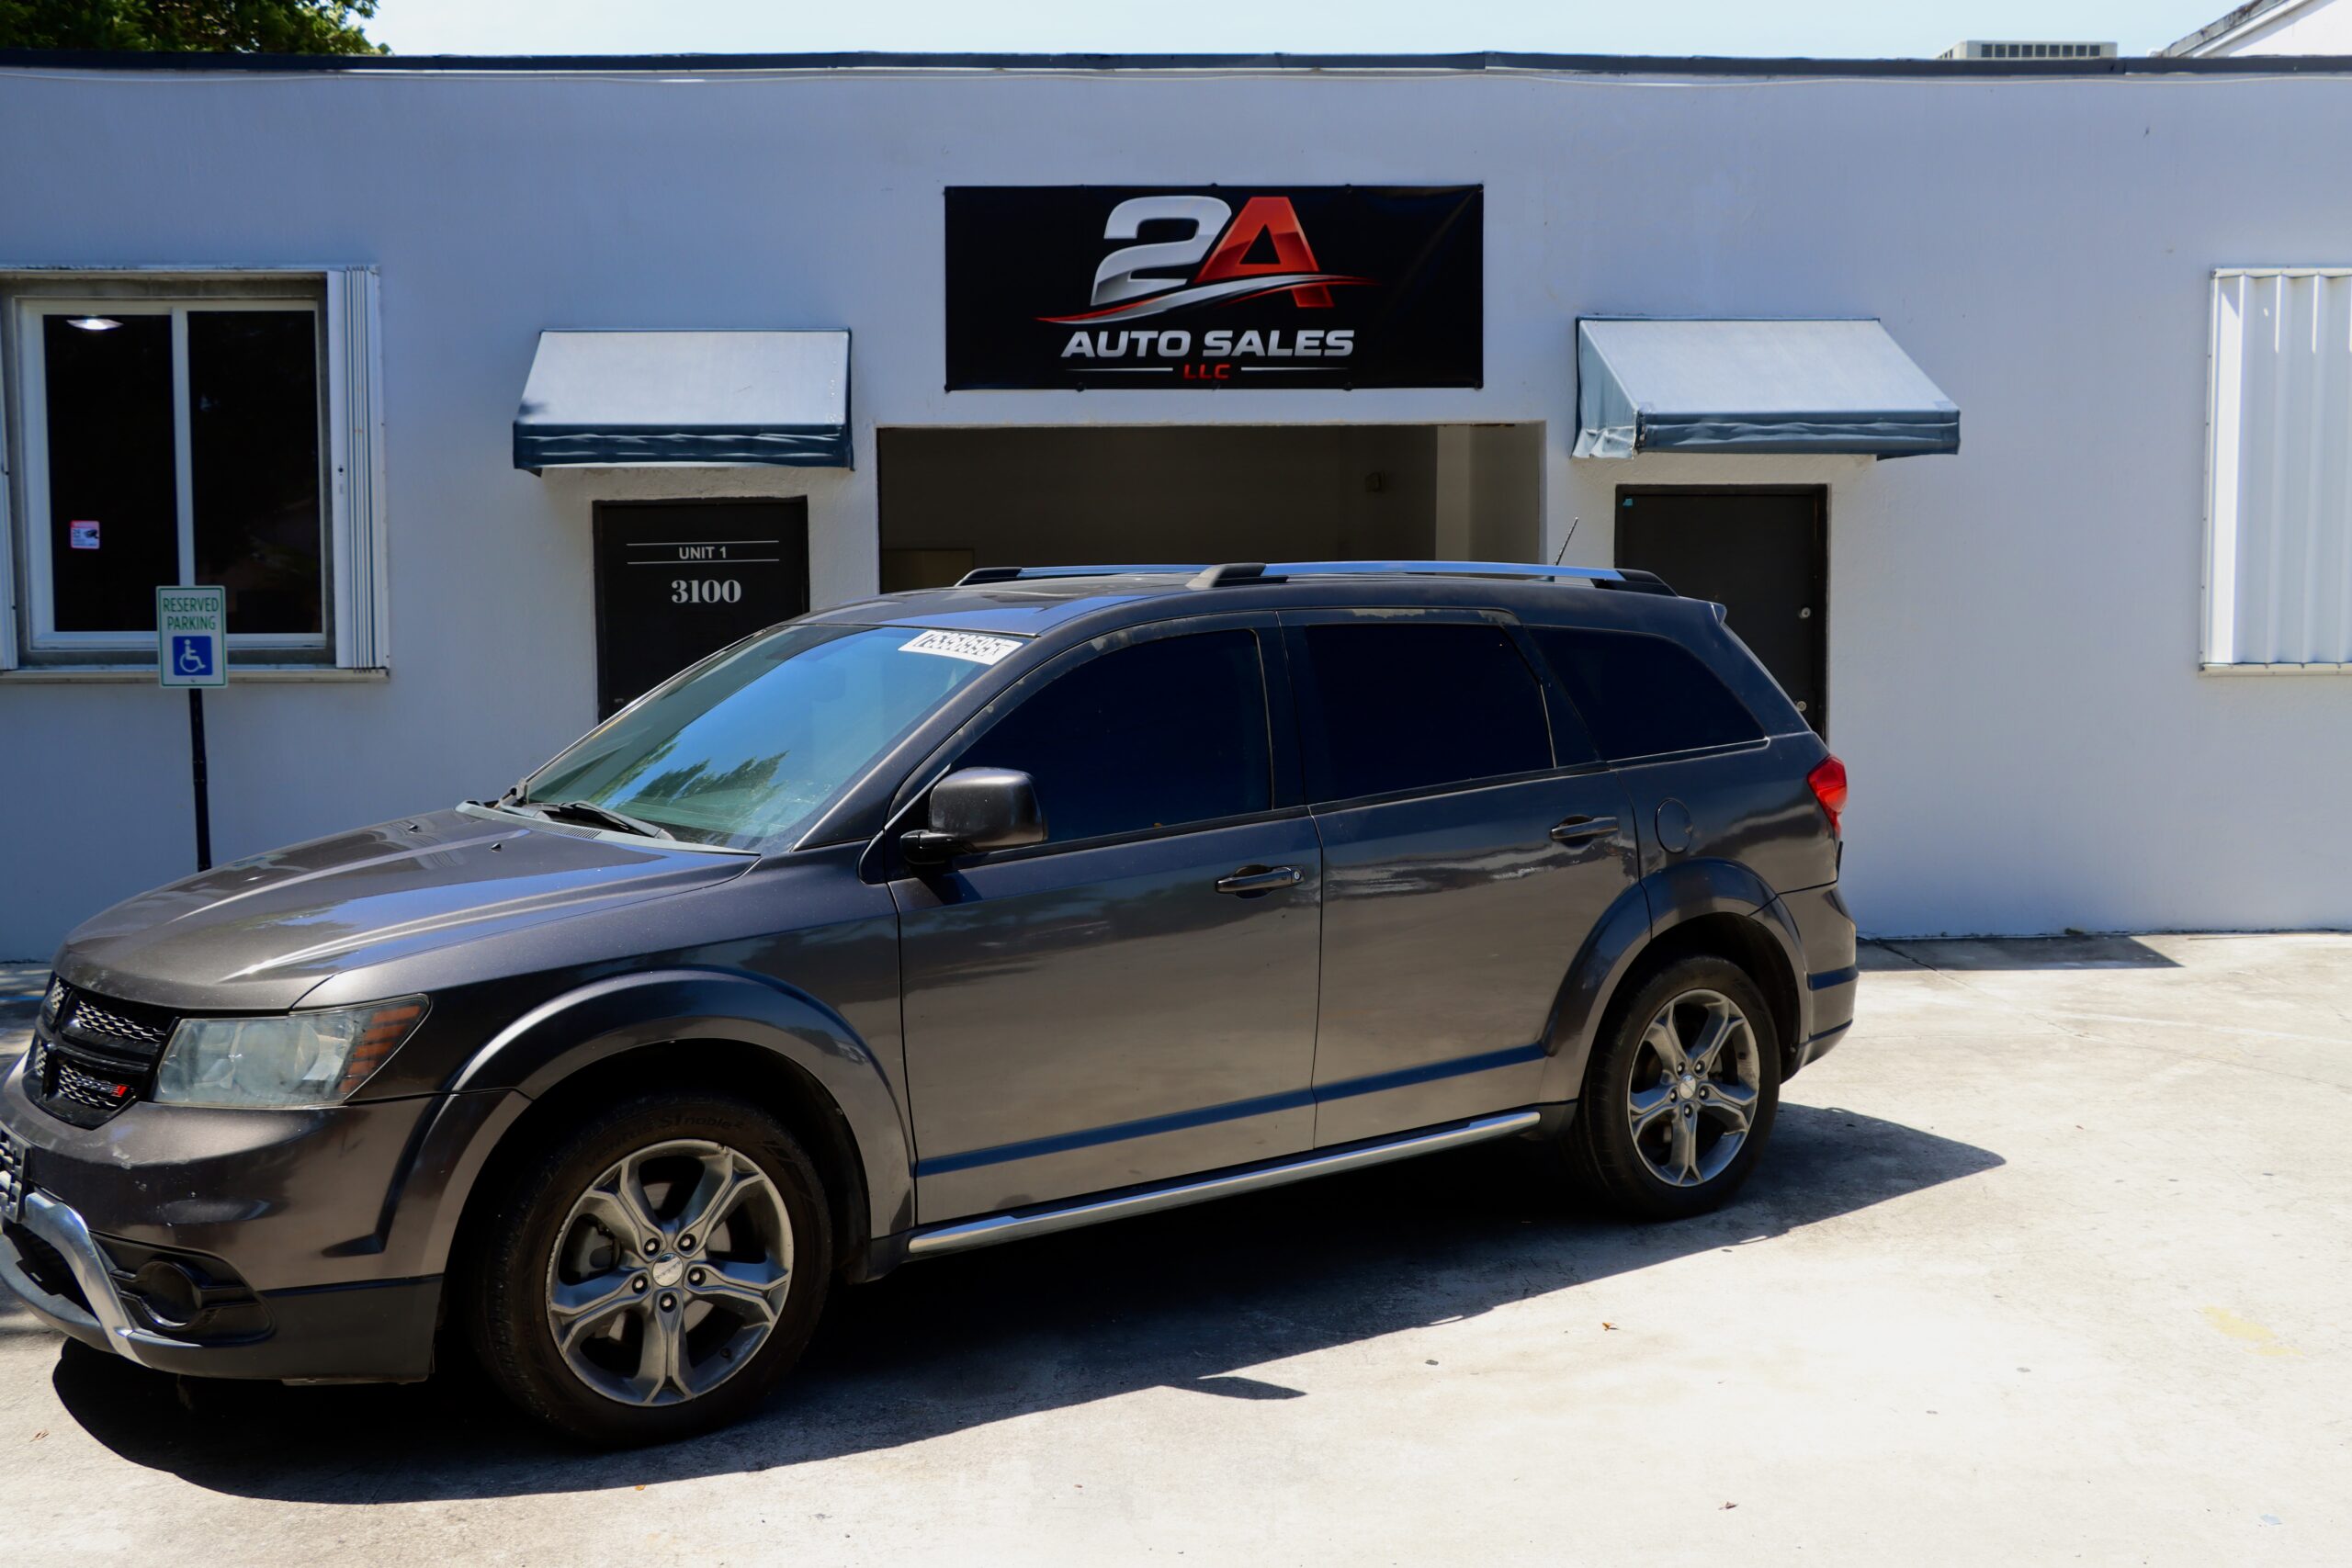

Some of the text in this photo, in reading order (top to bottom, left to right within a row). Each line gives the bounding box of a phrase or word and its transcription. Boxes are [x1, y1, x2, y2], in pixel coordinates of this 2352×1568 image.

[1091, 196, 1335, 307] 2A
[1060, 331, 1354, 357] AUTO SALES
[1183, 364, 1231, 379] LLC
[678, 546, 727, 559] UNIT 1
[671, 580, 741, 604] 3100
[163, 597, 219, 613] RESERVED
[167, 615, 216, 630] PARKING
